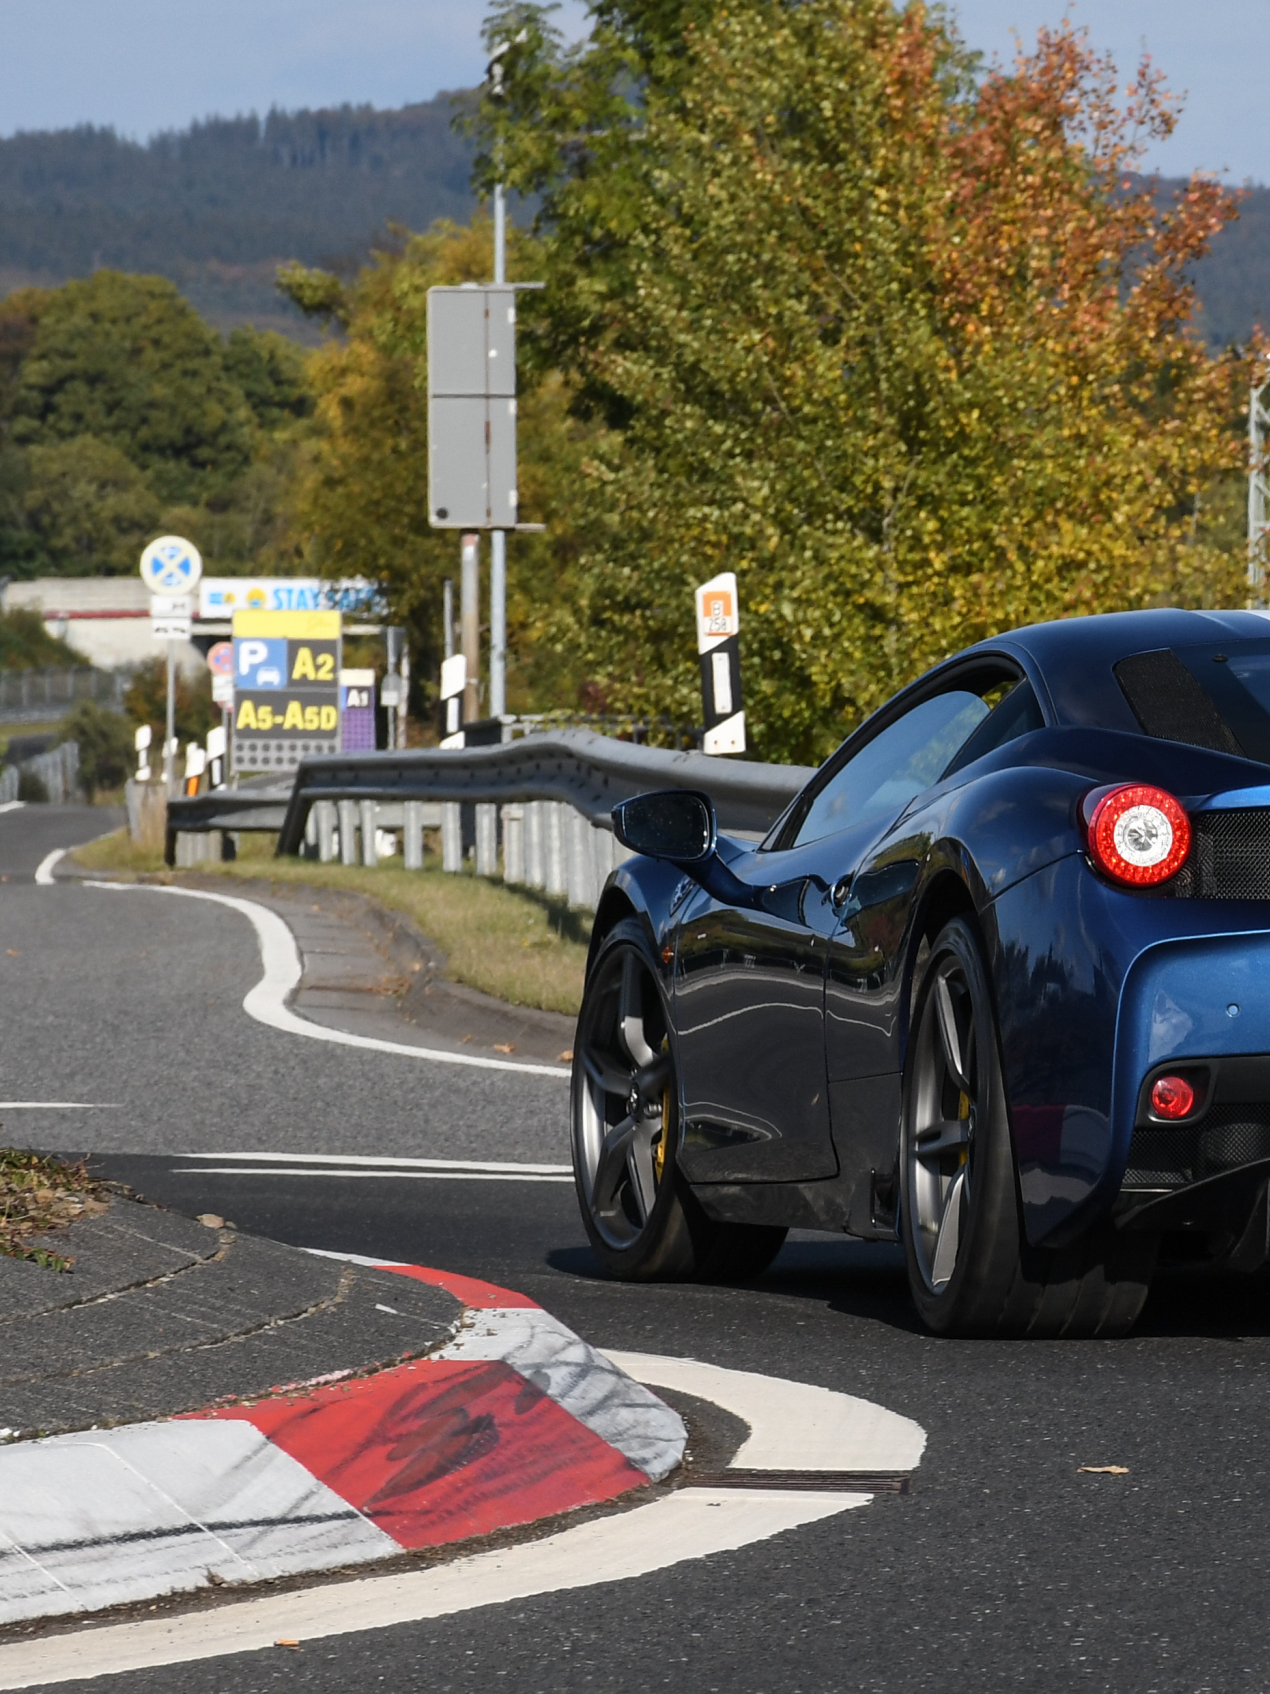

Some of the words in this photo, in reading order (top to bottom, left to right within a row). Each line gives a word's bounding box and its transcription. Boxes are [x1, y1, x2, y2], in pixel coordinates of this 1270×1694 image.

[273, 588, 320, 610] STAY
[239, 641, 268, 676] P
[292, 647, 335, 681] A2
[346, 688, 369, 708] A1
[236, 699, 338, 730] A5-A5D
